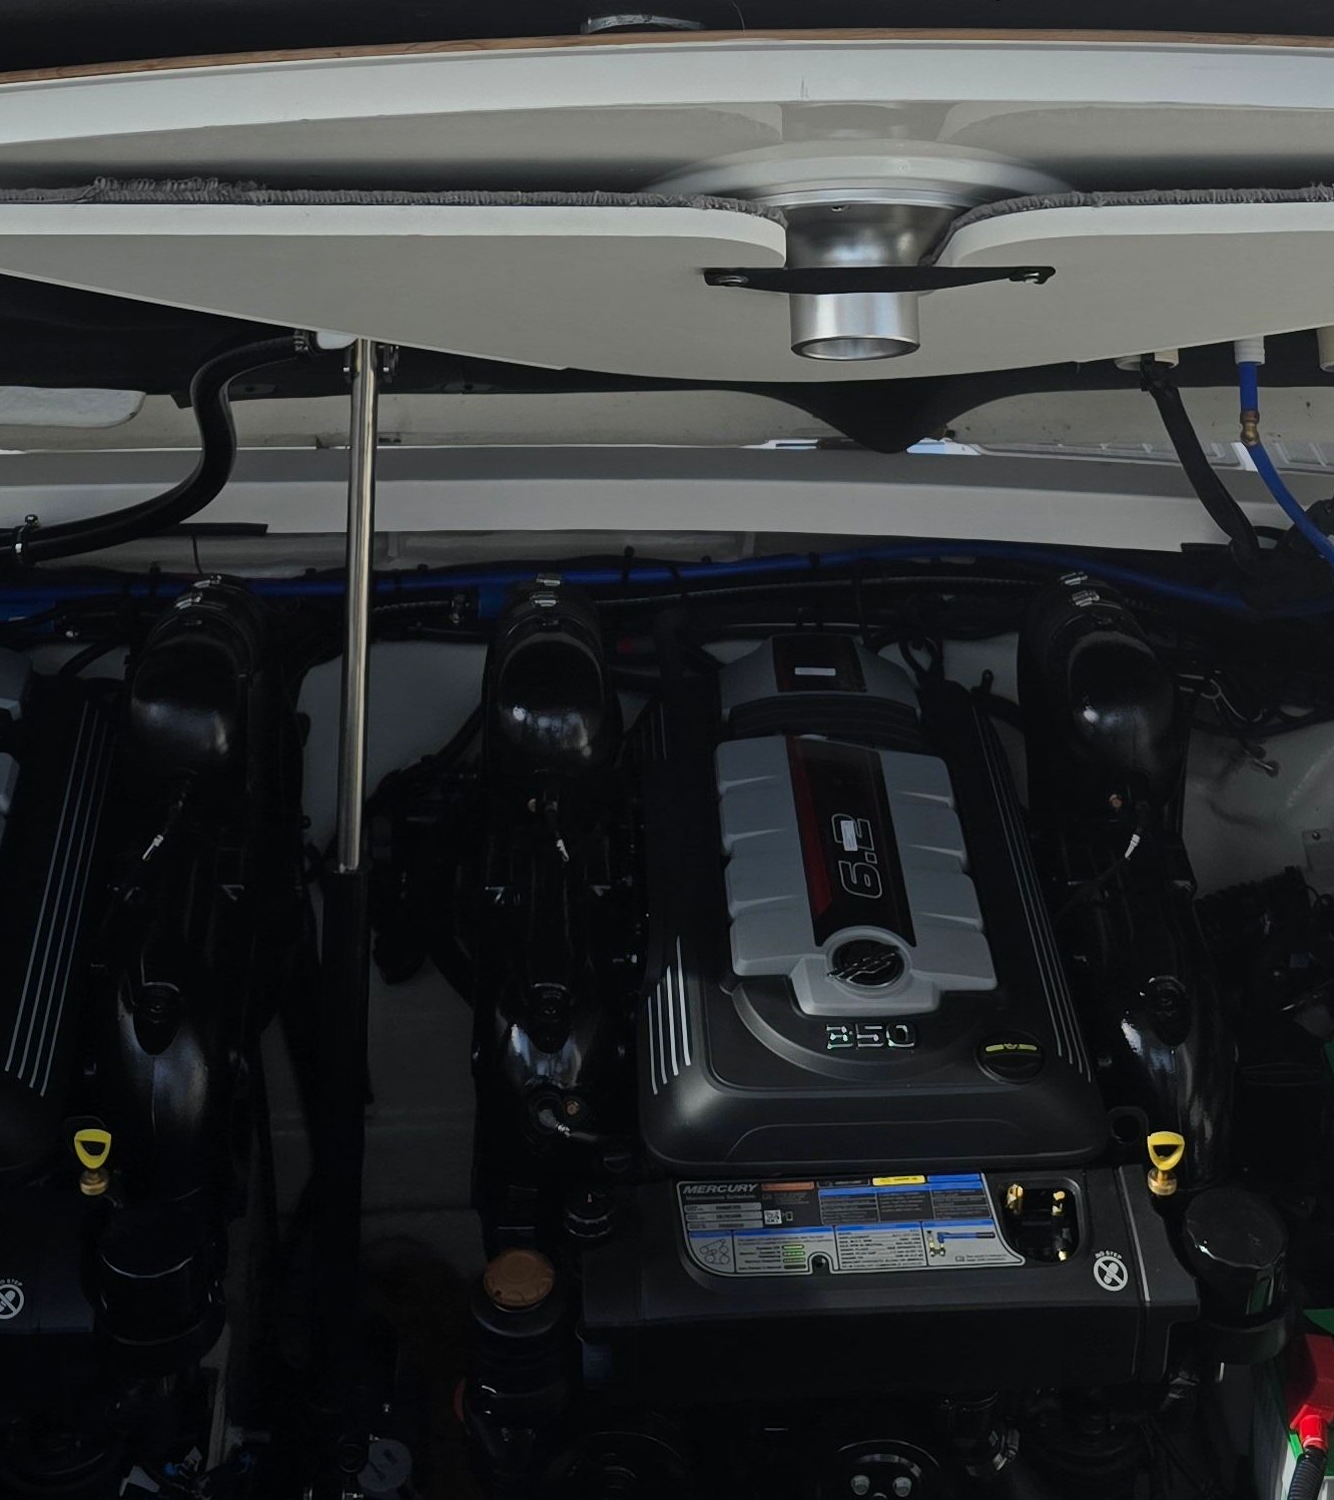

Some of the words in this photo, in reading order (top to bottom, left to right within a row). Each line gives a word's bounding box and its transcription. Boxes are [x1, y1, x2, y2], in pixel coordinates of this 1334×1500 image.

[831, 812, 883, 900] 6.2
[826, 1023, 916, 1050] 350
[682, 1183, 760, 1194] MERCURY
